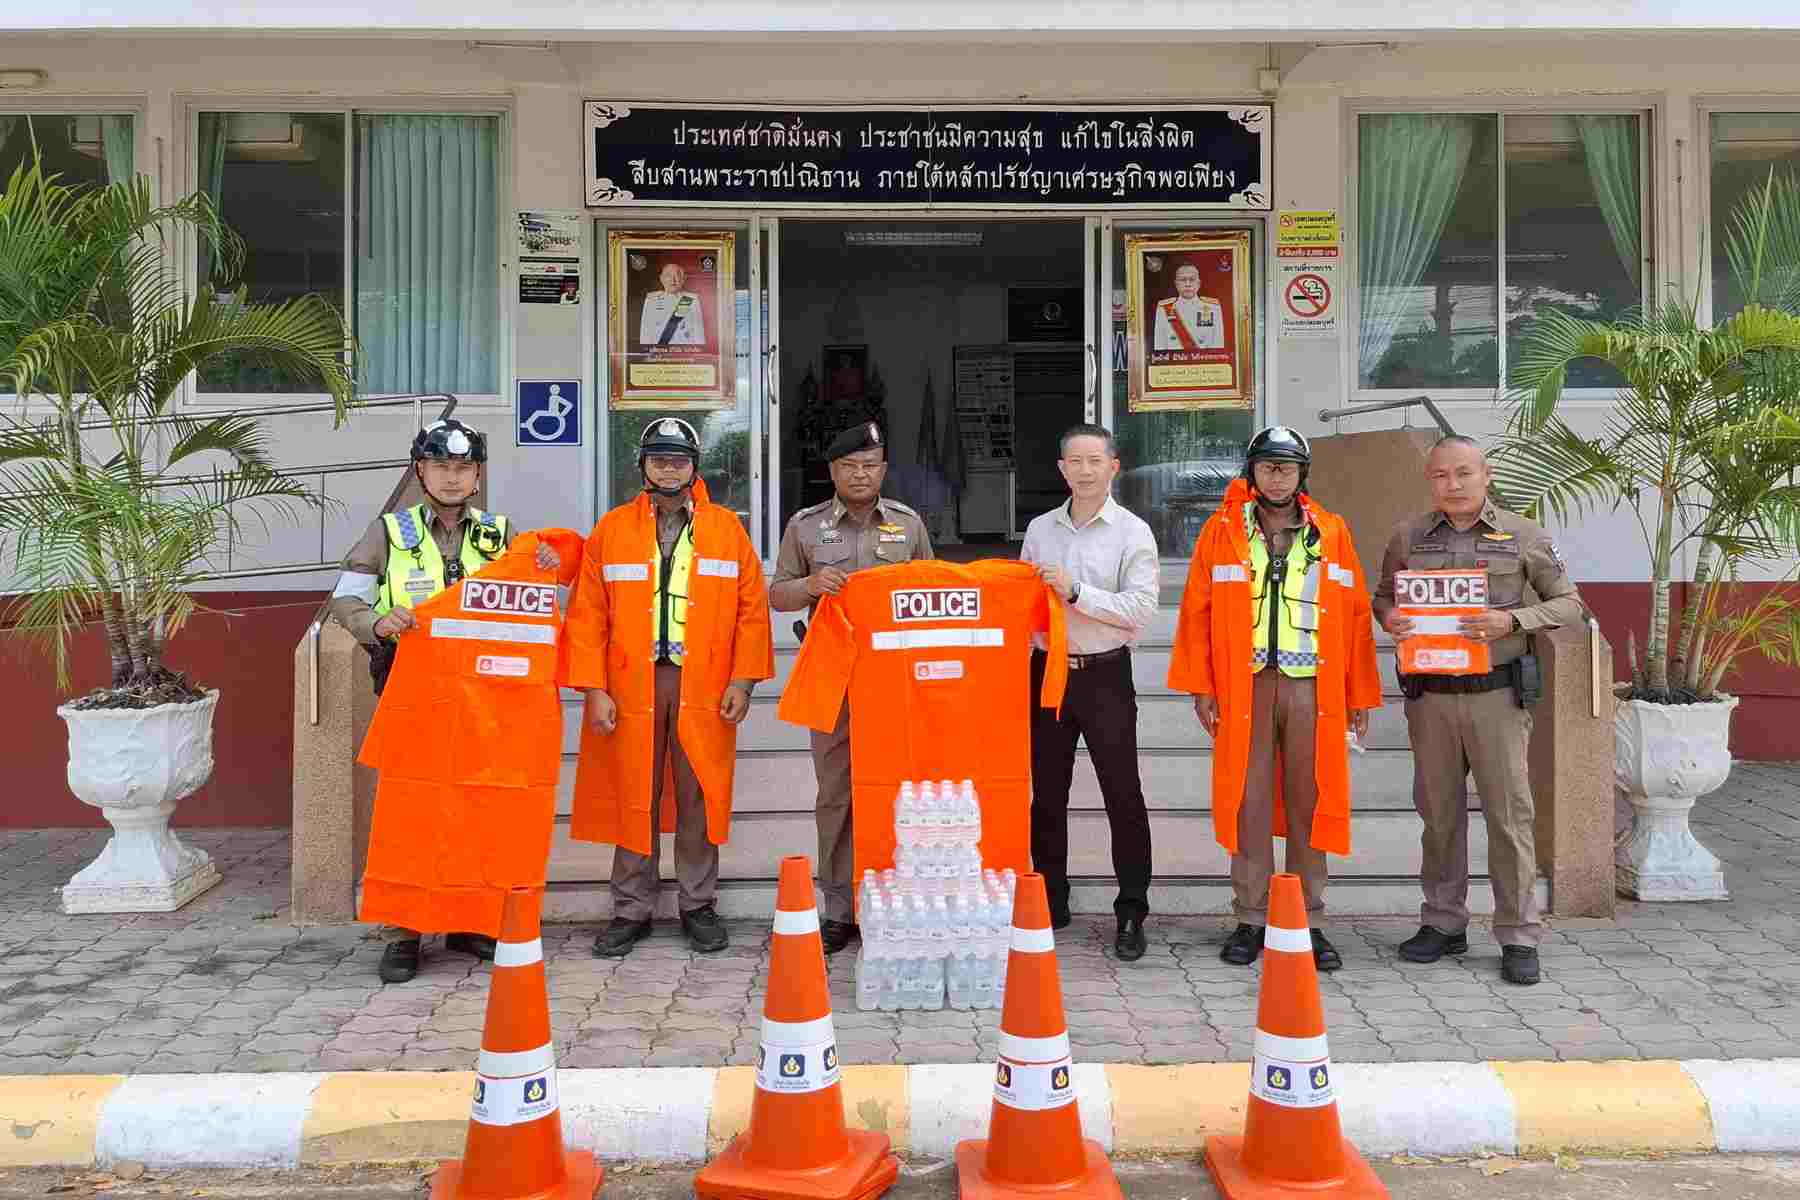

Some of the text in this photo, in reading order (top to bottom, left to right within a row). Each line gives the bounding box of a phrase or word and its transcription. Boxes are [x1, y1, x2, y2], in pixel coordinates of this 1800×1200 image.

[672, 116, 1195, 155] ประเทศชาติมั่นคง ประชาชนมีความสุข แก้ไขในสิ่งผิด
[627, 158, 1236, 196] สืบสานพระราชปณิธาน ภายใต้หลักปรัชญาเศรษฐกิจพอเพียง
[465, 581, 555, 613] POLICE
[895, 591, 978, 617] POLICE
[1394, 576, 1486, 604] POLICE
